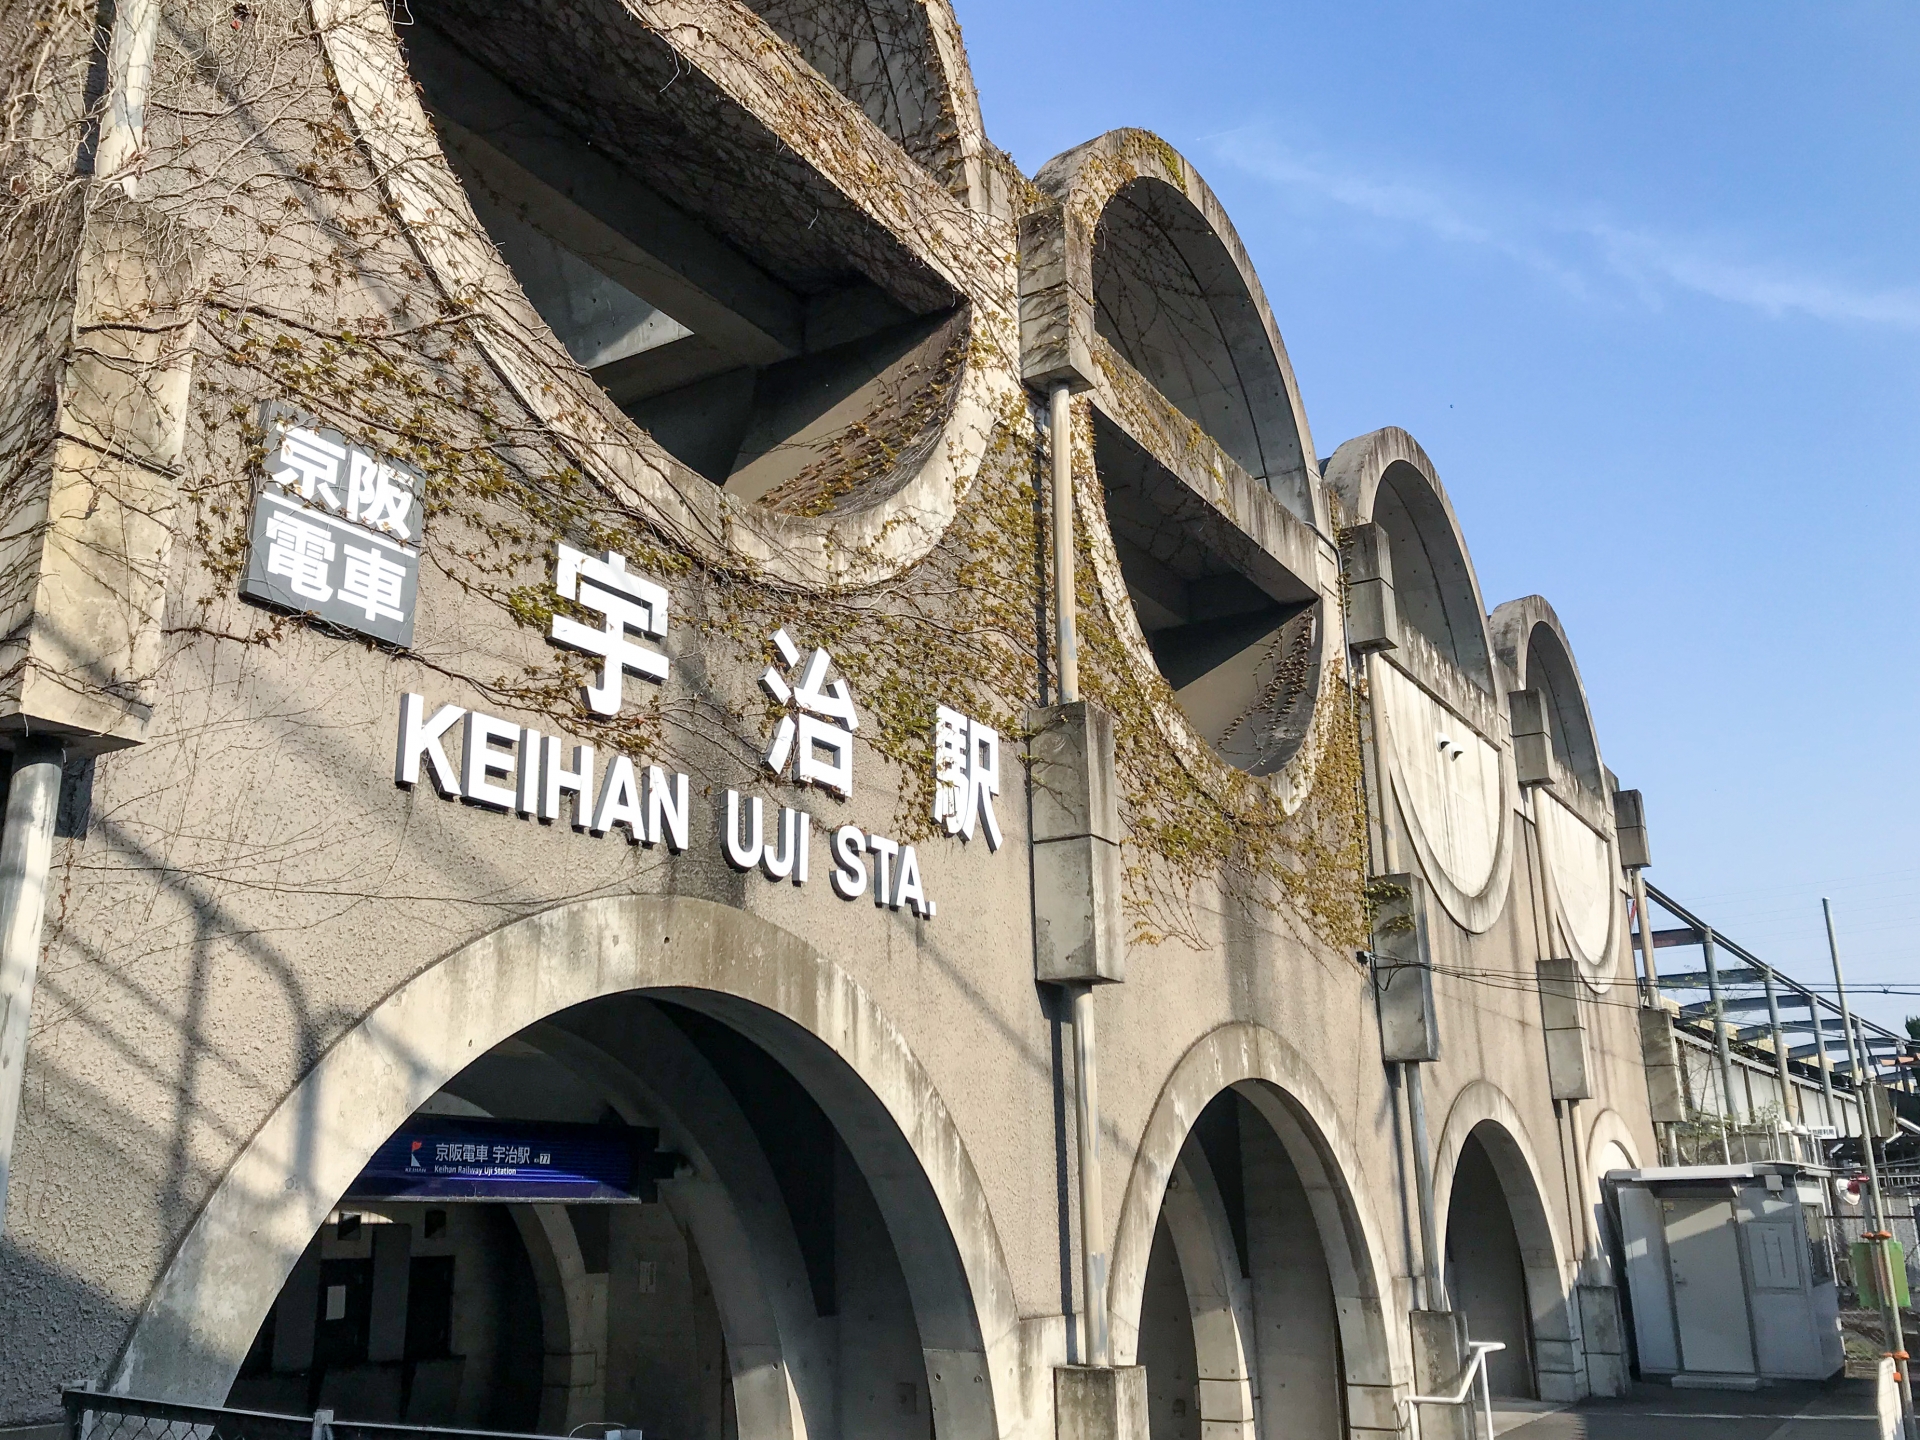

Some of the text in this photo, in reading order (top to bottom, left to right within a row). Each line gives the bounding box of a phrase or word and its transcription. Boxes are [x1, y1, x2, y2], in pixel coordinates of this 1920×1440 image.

[272, 422, 417, 540] 京阪
[265, 510, 407, 622] 電車
[546, 542, 1003, 853] 宇治駅
[396, 692, 937, 919] KEIHAN UJI STA.
[434, 1164, 517, 1177] Keihan Railway Uji Station
[435, 1143, 531, 1165] 京阪電車 宇治駅
